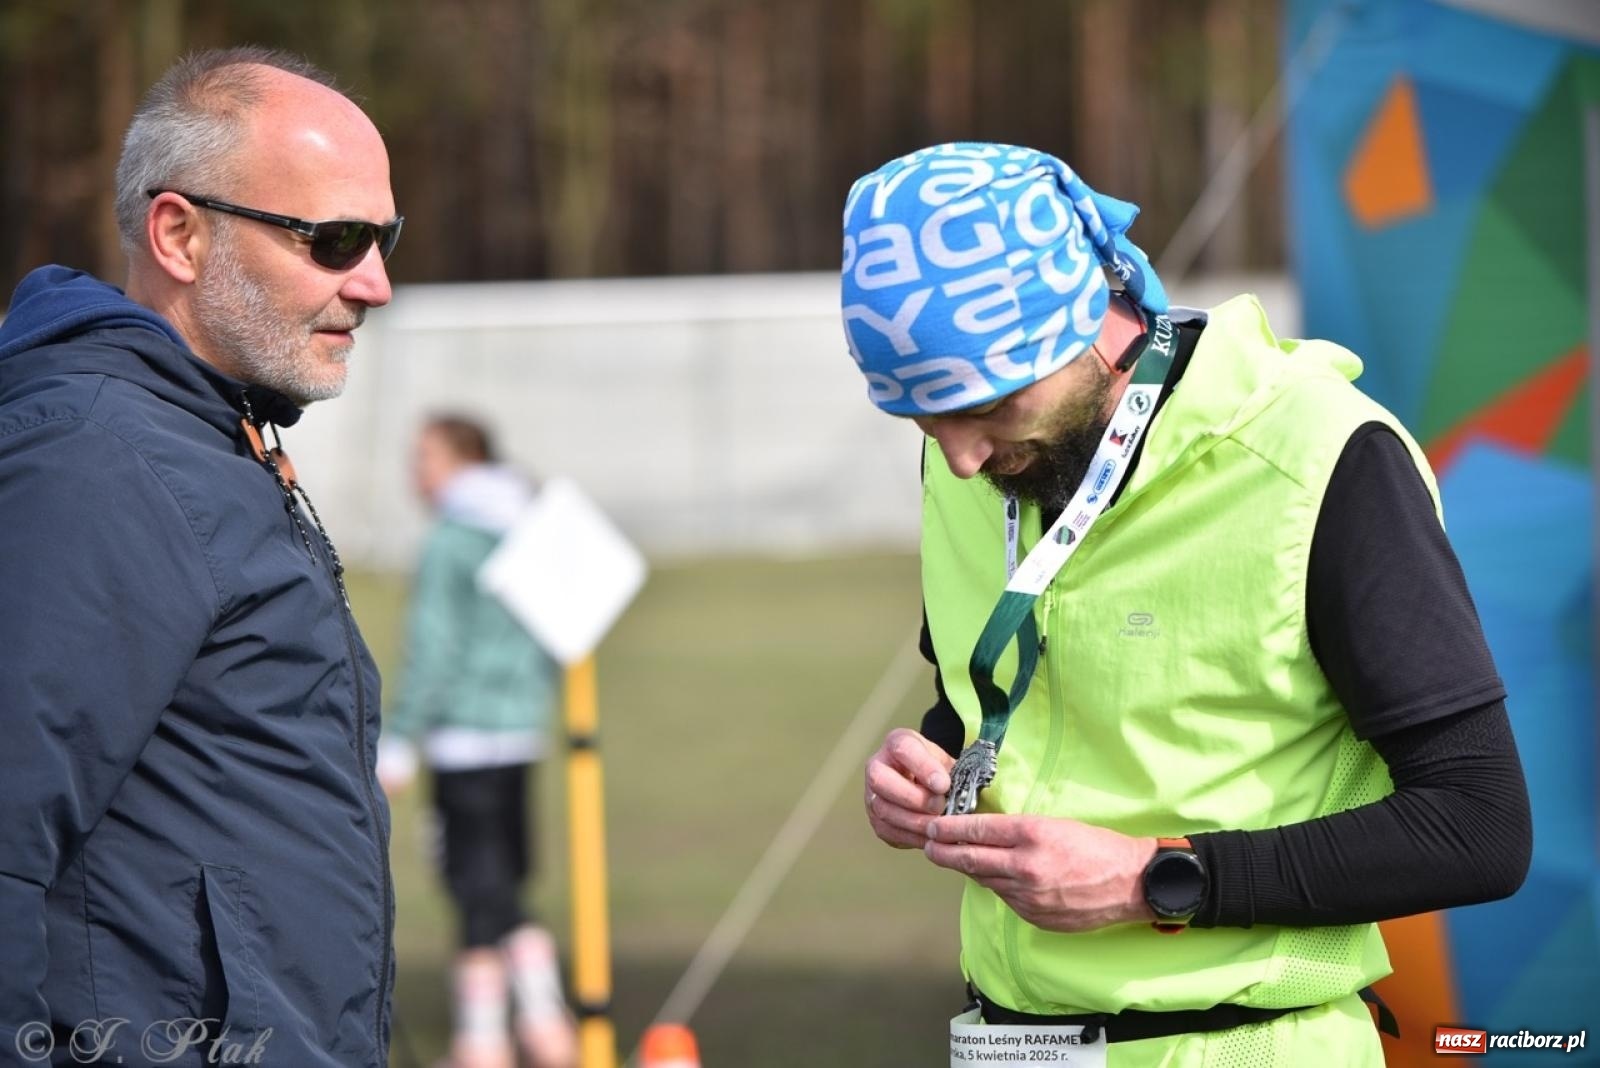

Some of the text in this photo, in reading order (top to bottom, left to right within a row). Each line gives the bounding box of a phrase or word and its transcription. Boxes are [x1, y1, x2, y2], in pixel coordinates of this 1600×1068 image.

[988, 1034, 1022, 1047] Leśny
[968, 1050, 975, 1060] 5
[976, 1050, 1026, 1061] kwietnia
[1029, 1050, 1058, 1061] 2025
[1060, 1052, 1069, 1061] r.
